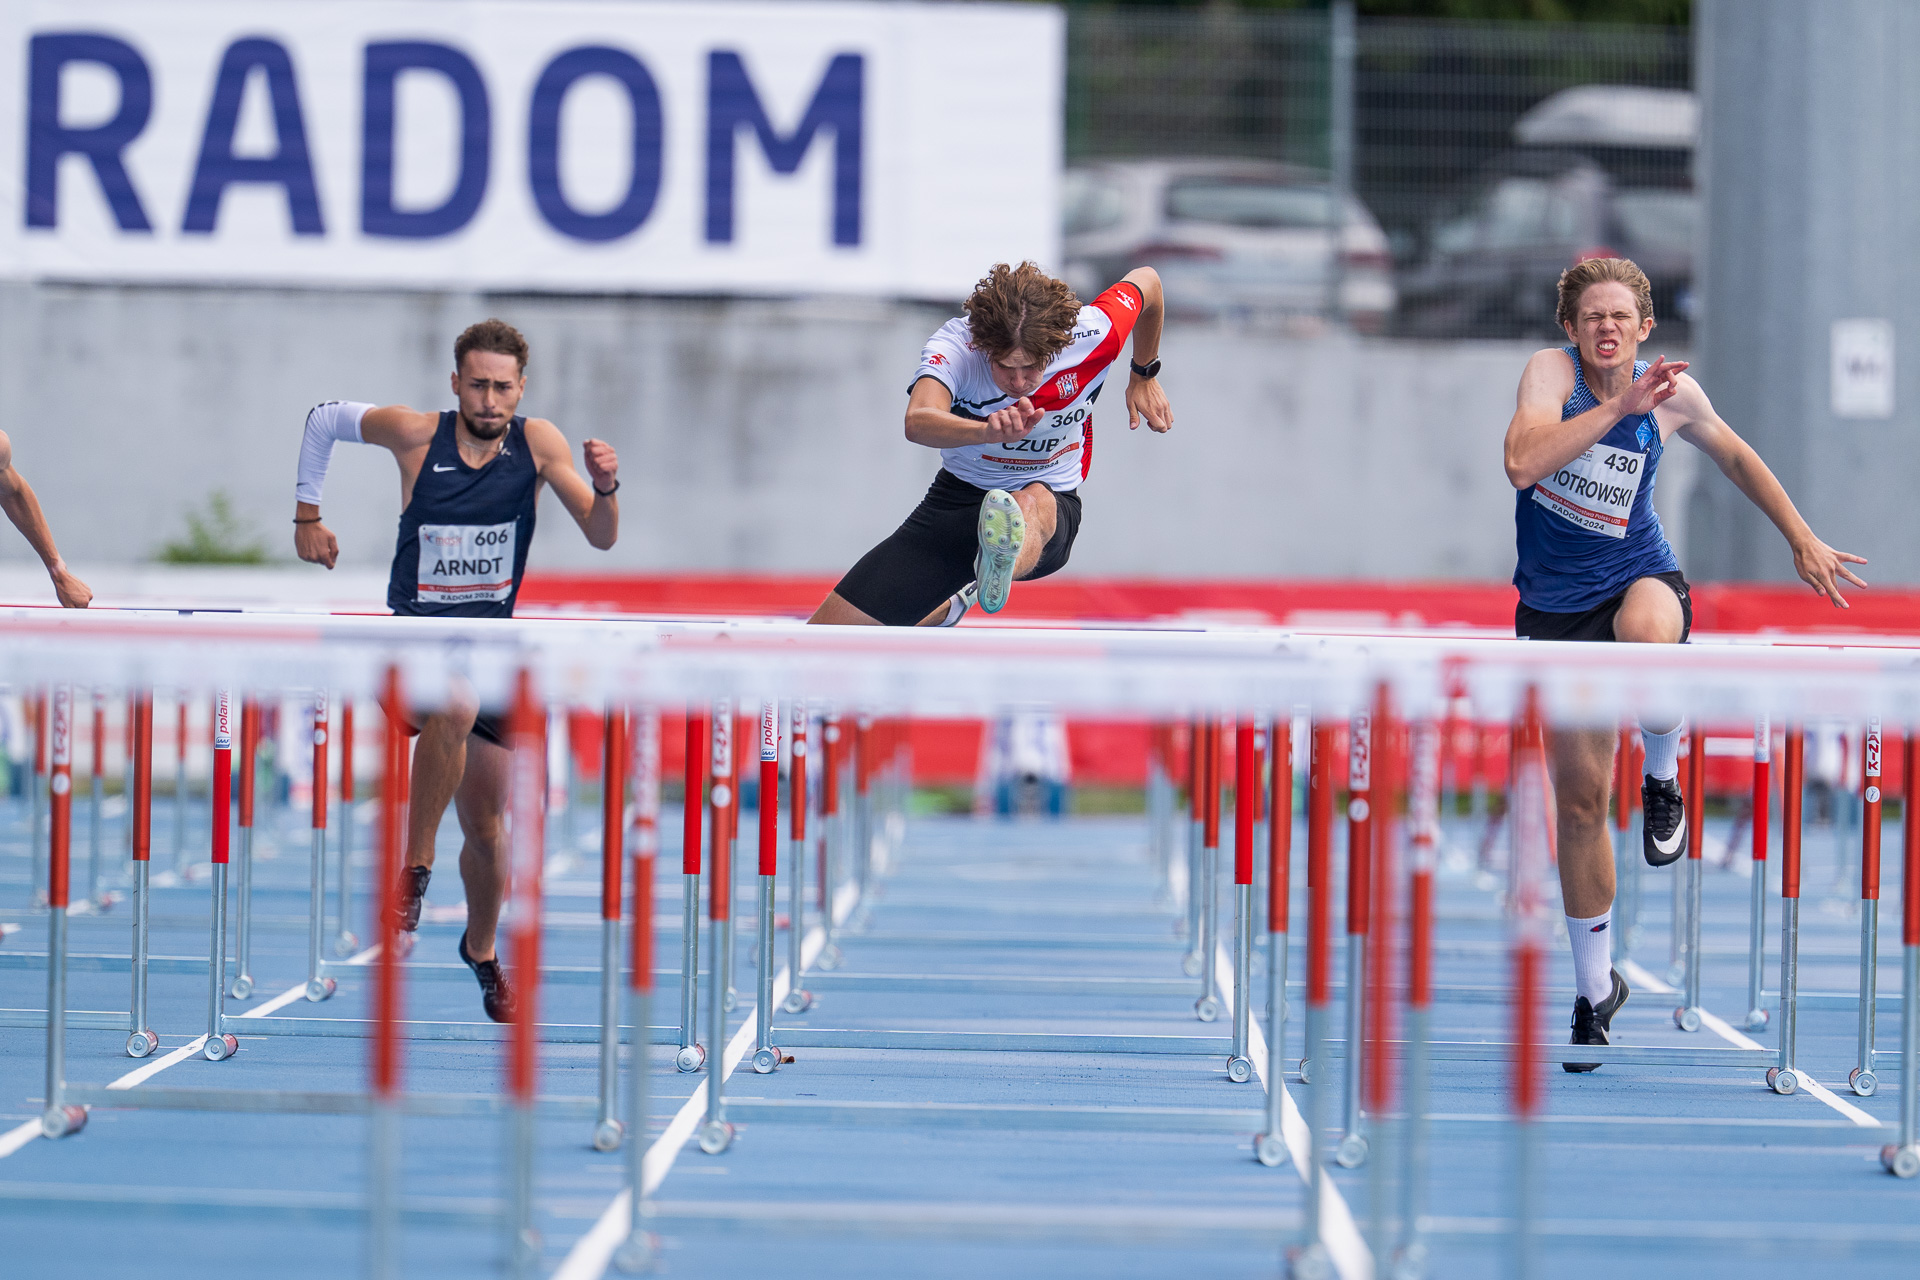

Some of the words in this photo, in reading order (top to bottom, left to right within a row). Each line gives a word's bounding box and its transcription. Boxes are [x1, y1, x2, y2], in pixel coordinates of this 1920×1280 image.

[24, 31, 867, 247] RADOM
[1051, 408, 1085, 428] 360
[1002, 435, 1067, 453] CZUB
[1039, 460, 1059, 470] 2024
[1604, 453, 1638, 475] 430
[1552, 470, 1633, 508] IOTROWSKI
[1551, 503, 1583, 524] RADOM
[1584, 519, 1605, 531] 2024
[475, 528, 508, 546] 606
[432, 557, 503, 577] ARNDT
[440, 594, 473, 602] RADOM
[1867, 716, 1880, 771] OLANIK
